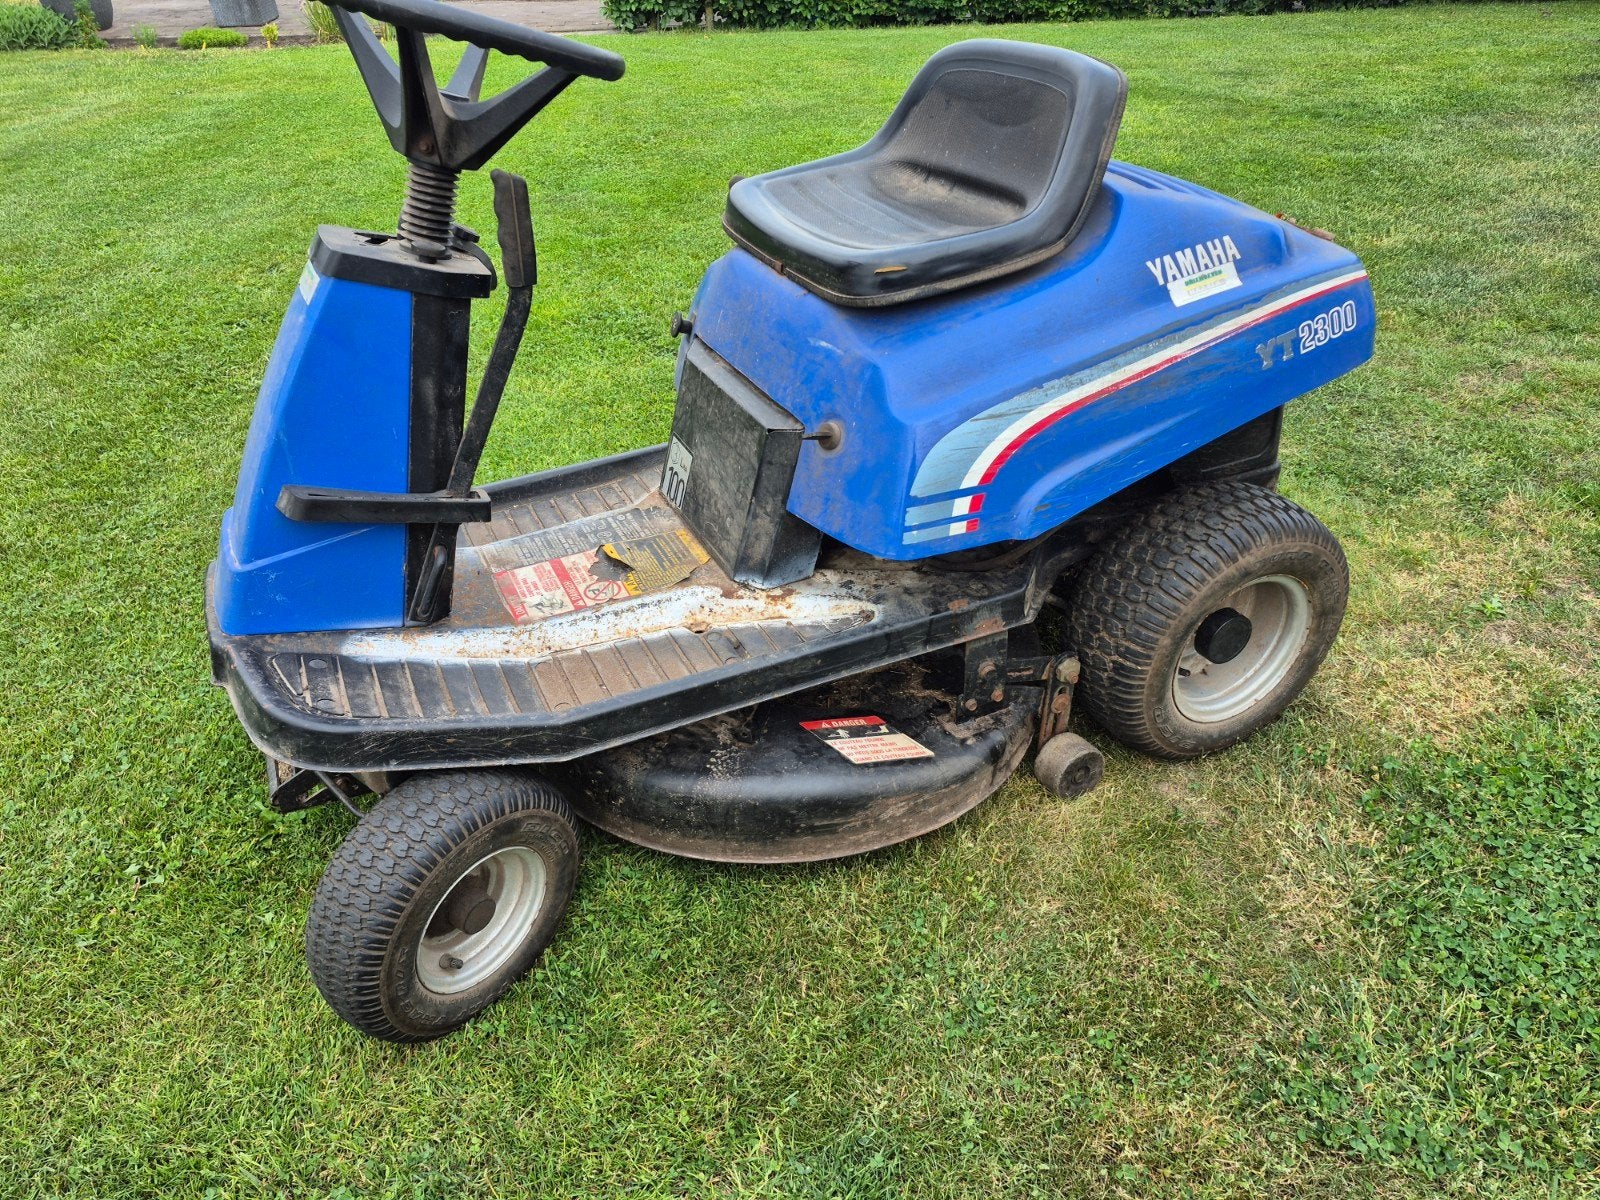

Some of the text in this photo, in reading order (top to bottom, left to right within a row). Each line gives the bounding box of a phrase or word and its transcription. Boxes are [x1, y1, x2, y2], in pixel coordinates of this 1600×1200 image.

[1145, 235, 1242, 286] YAMAHA
[1256, 300, 1357, 370] YT 2300
[666, 466, 685, 509] 100
[832, 719, 867, 728] DANGER
